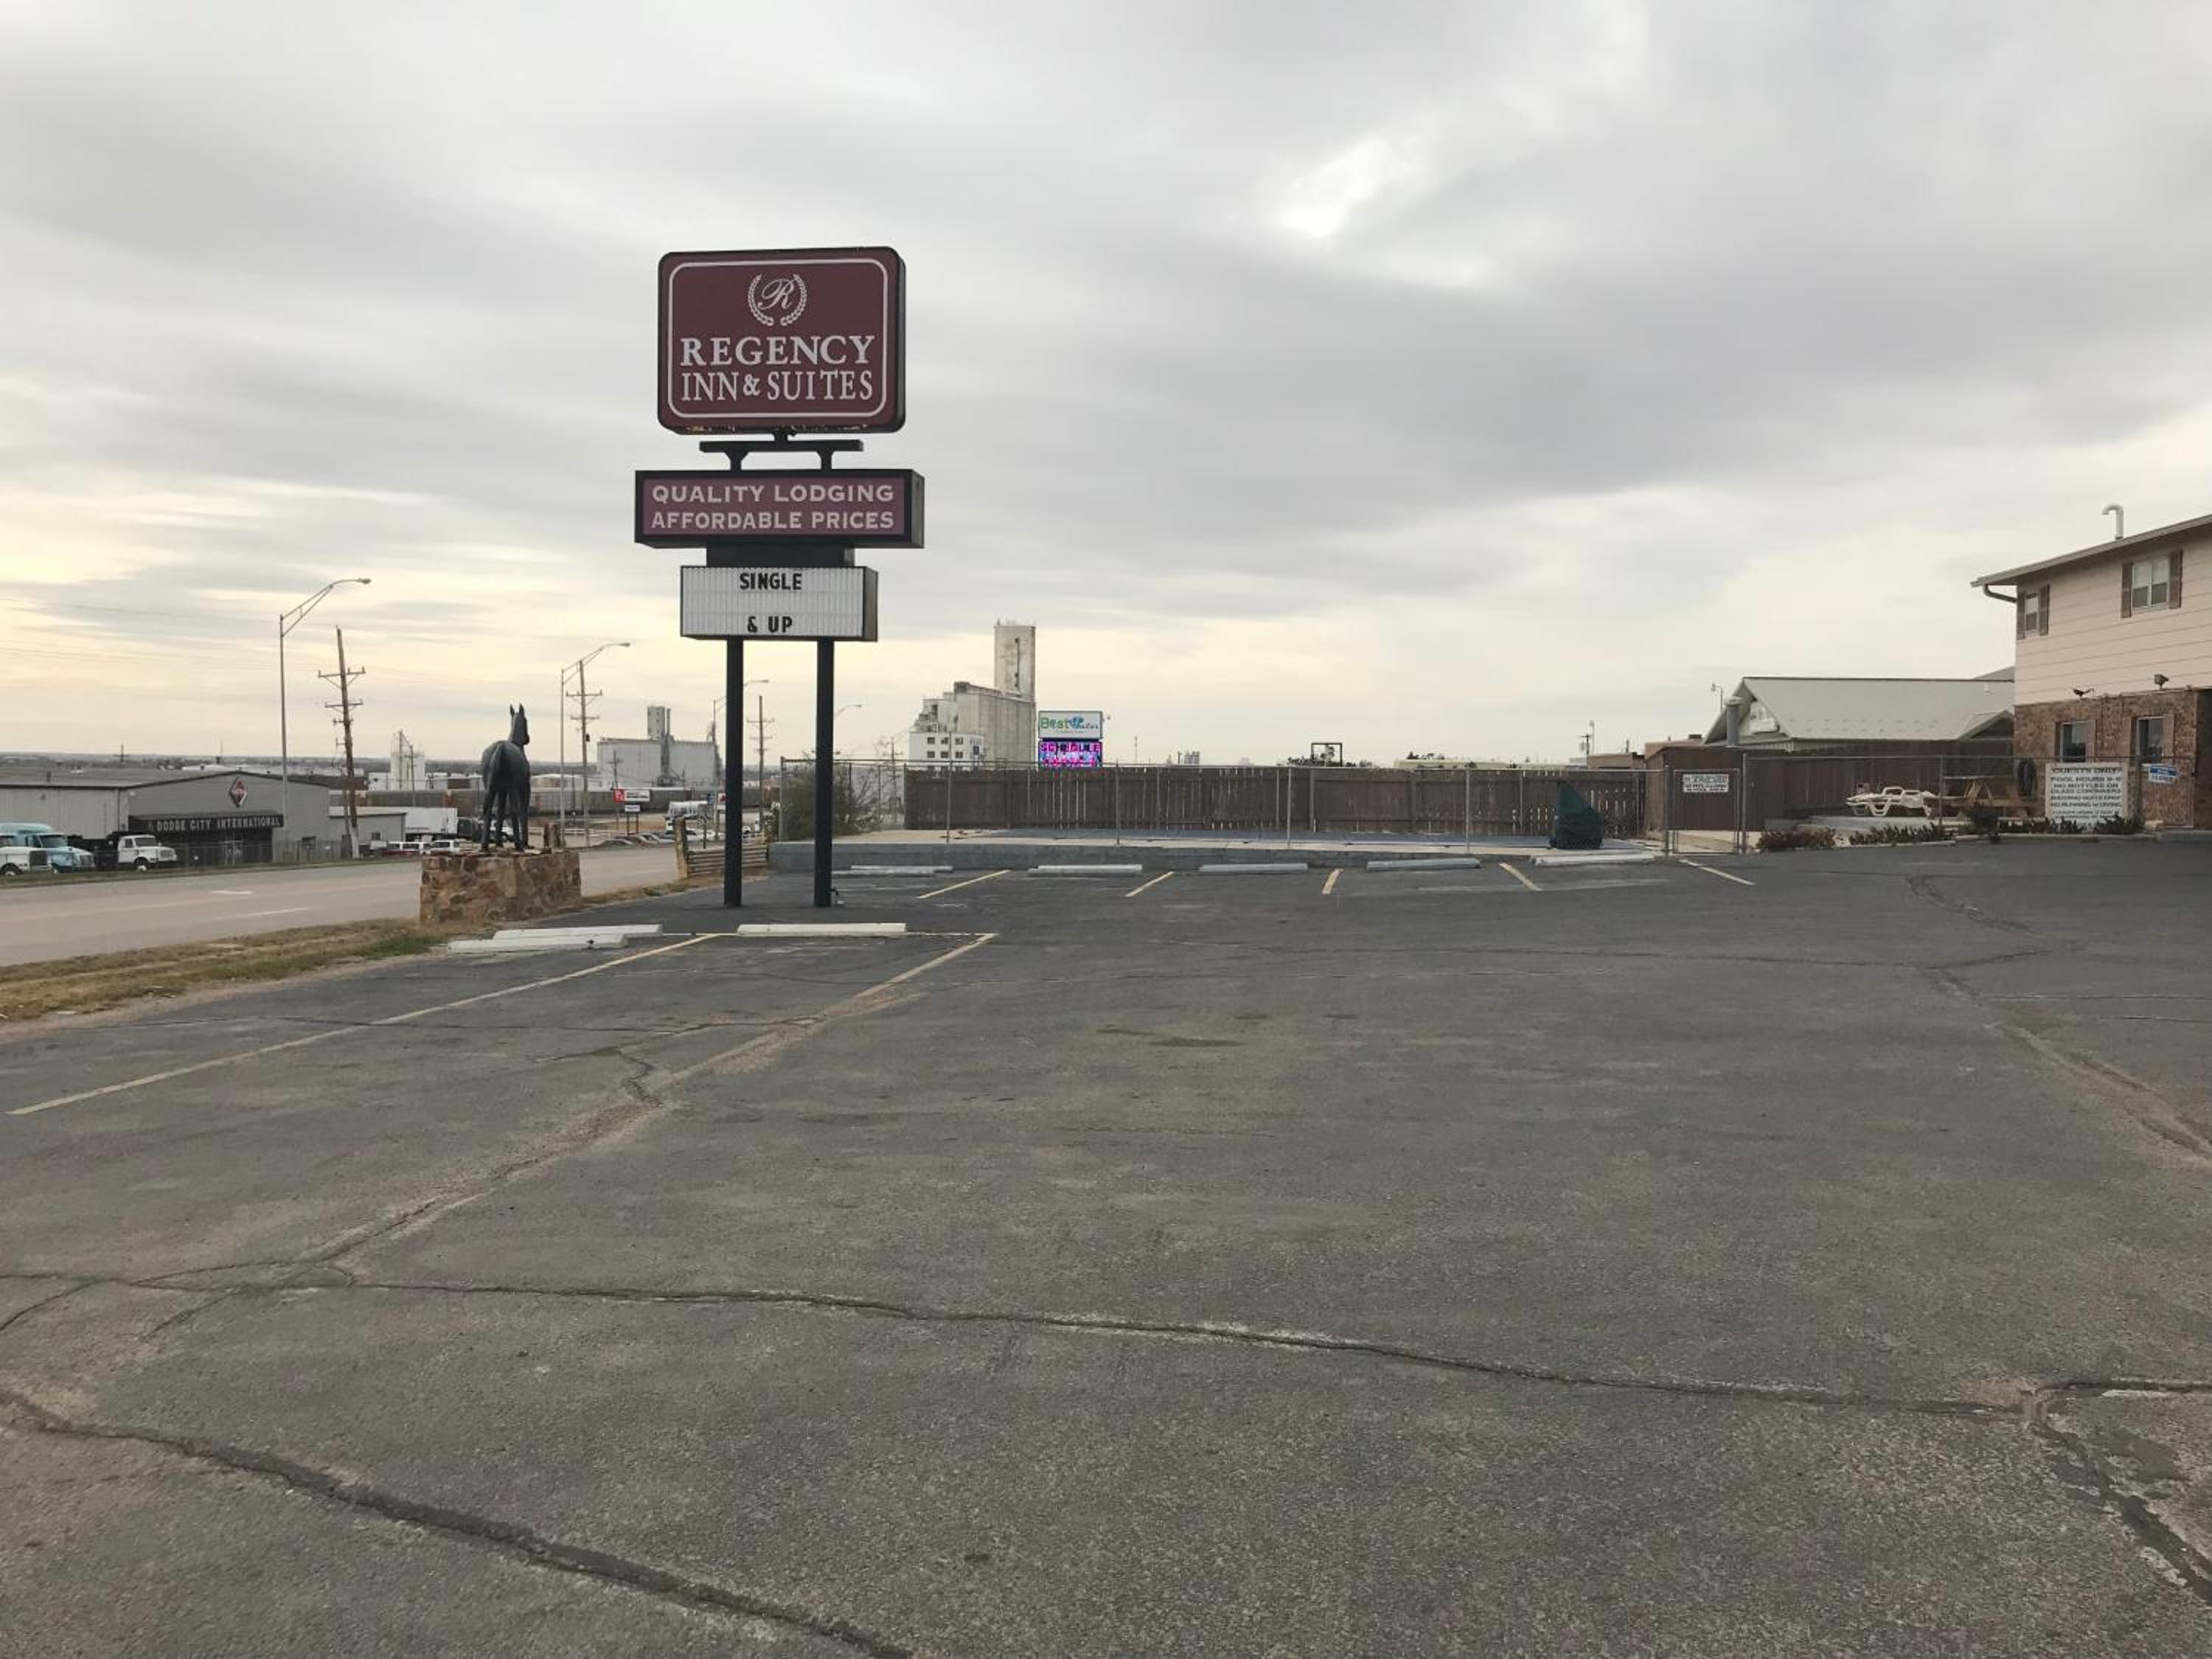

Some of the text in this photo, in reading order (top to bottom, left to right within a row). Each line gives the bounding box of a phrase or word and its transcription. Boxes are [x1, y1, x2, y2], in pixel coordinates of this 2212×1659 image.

[680, 335, 874, 366] REGENCY
[681, 369, 873, 401] INN & SUITES
[652, 484, 894, 503] QUALITY LODGING
[651, 512, 894, 529] AFFORDABLE PRICES
[740, 573, 802, 591] SINGLE
[747, 616, 793, 633] & UP
[157, 819, 187, 832] DODGE
[189, 818, 212, 832] CITY
[216, 816, 280, 829] INTERNATIONAL
